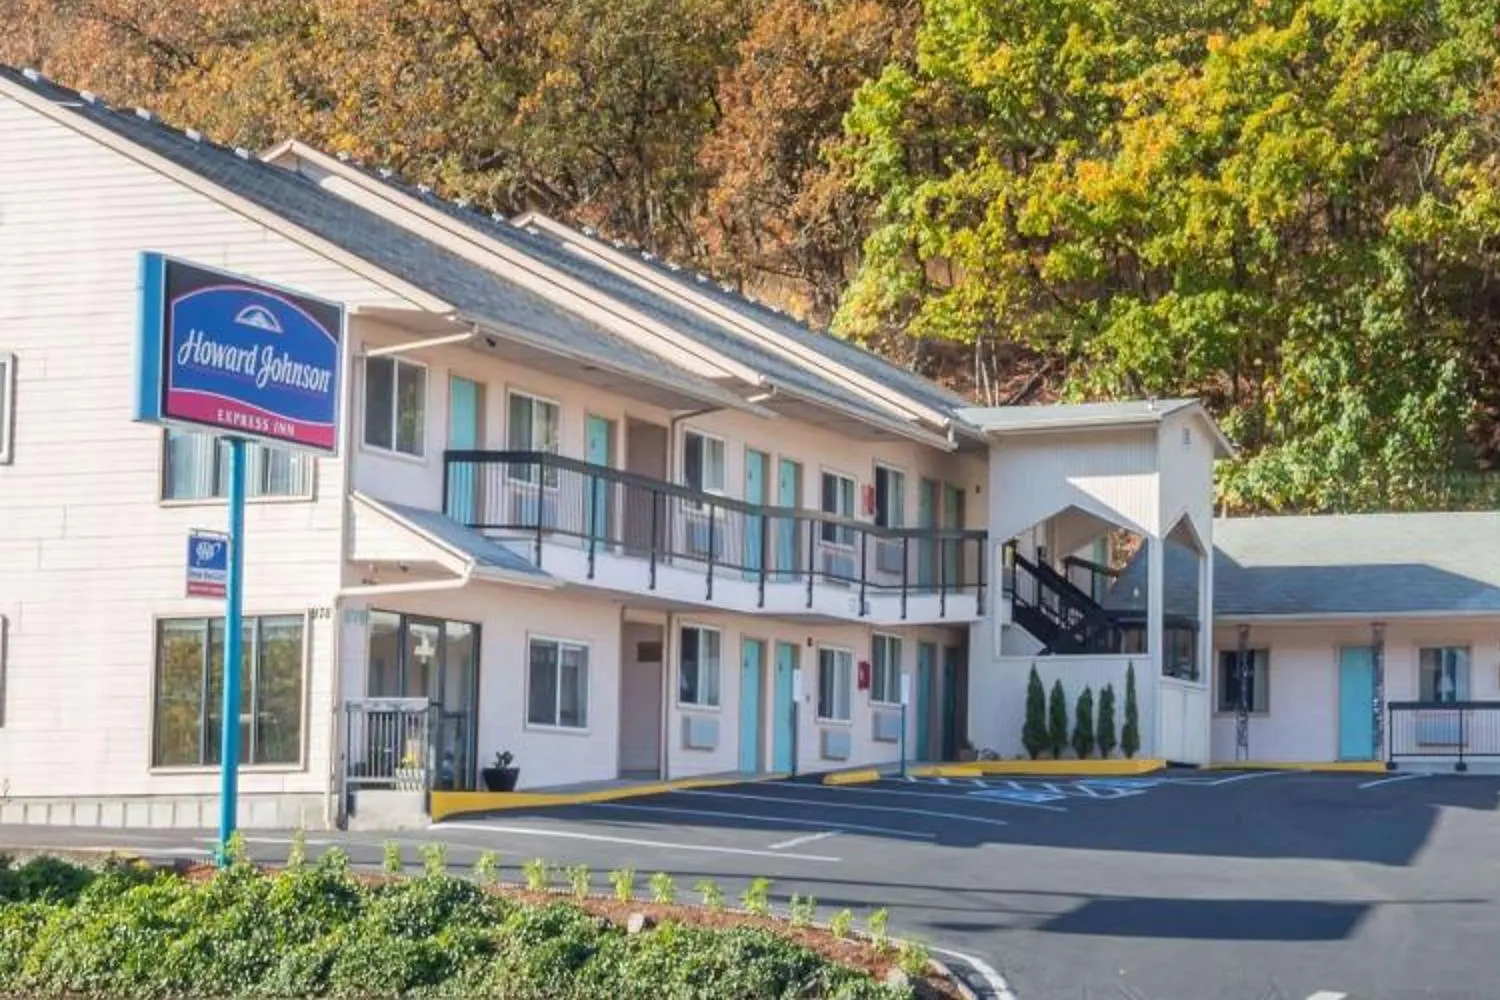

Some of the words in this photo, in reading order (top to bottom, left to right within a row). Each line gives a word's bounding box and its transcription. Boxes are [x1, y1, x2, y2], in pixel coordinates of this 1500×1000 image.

[177, 327, 258, 377] Howard
[255, 344, 333, 393] Johnson
[217, 408, 270, 432] EXPRESS
[273, 419, 296, 437] INN
